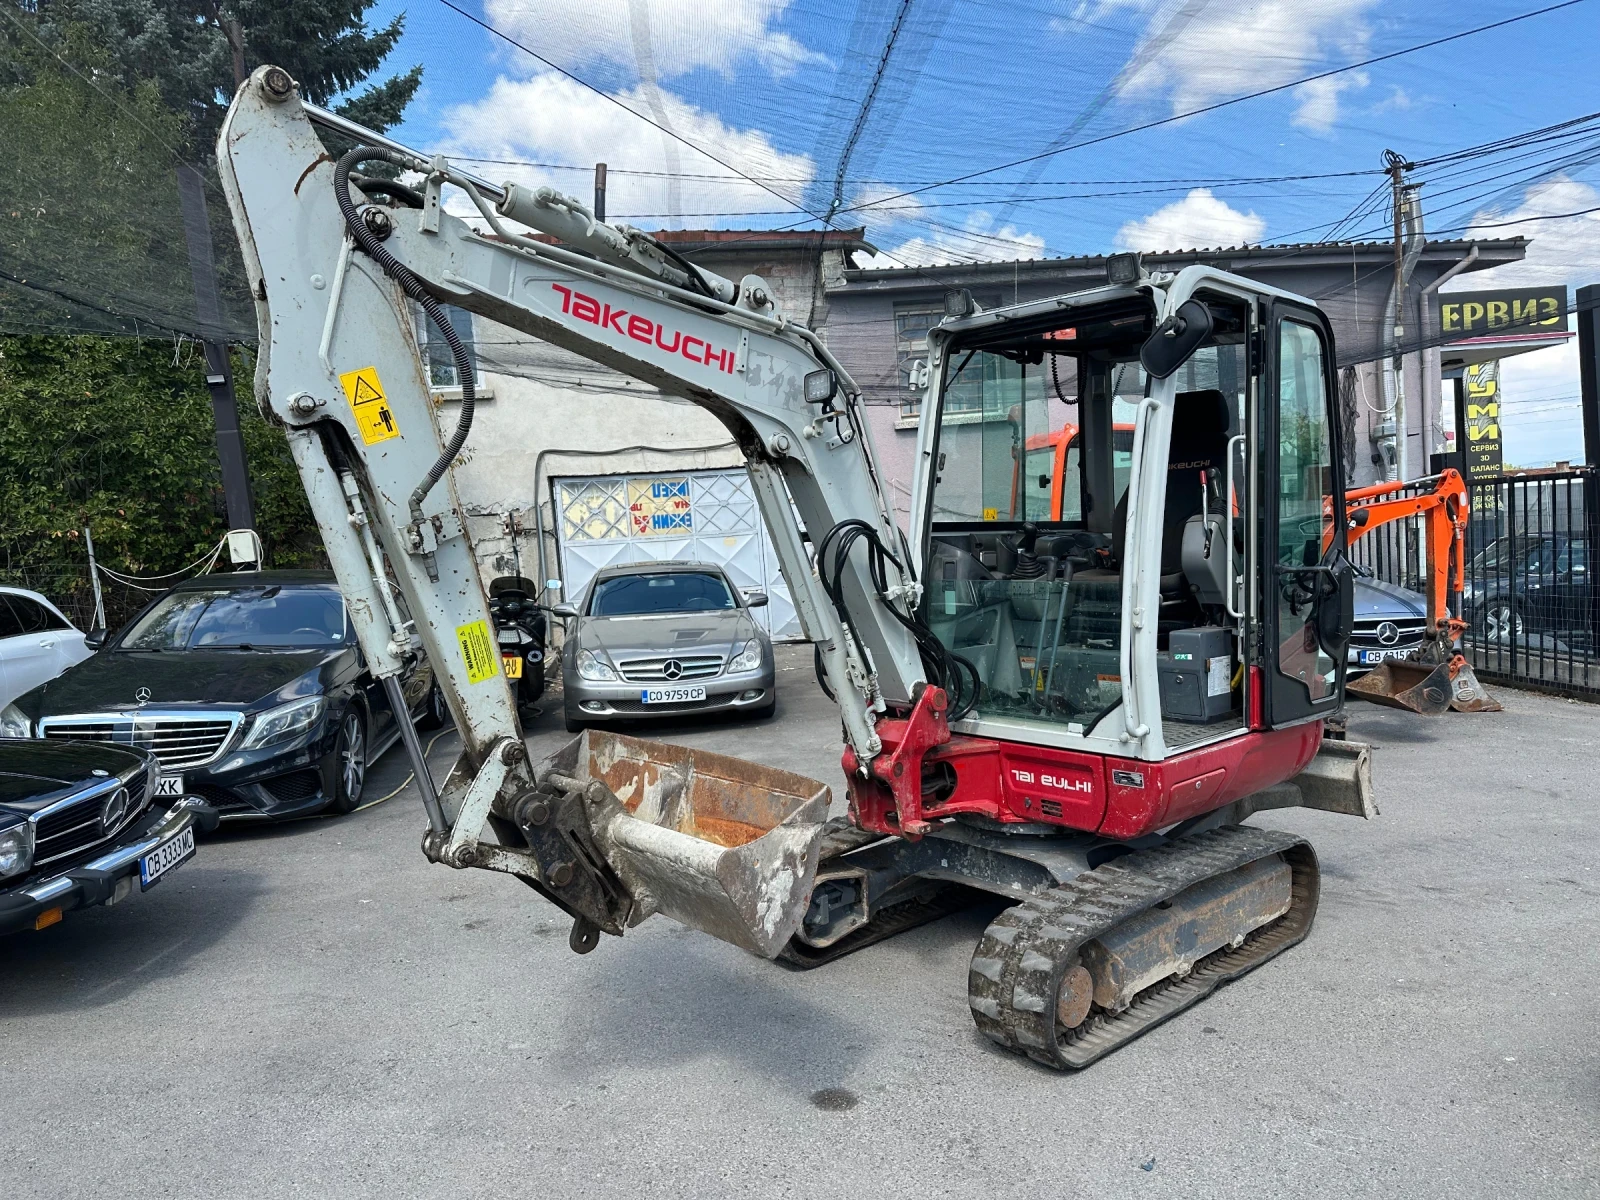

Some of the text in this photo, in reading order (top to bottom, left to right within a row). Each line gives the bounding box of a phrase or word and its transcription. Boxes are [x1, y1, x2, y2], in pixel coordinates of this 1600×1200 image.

[552, 283, 736, 375] TAKEUCHI
[1470, 444, 1499, 452] СЕРВИЗ
[1167, 459, 1211, 470] KEUCHI
[1470, 464, 1500, 472] БАЛАНС
[461, 640, 474, 670] WARNING
[649, 689, 704, 701] CO 9759 CP
[159, 780, 179, 794] XK
[147, 853, 161, 877] CB
[161, 838, 182, 868] 3333
[182, 829, 193, 853] MC
